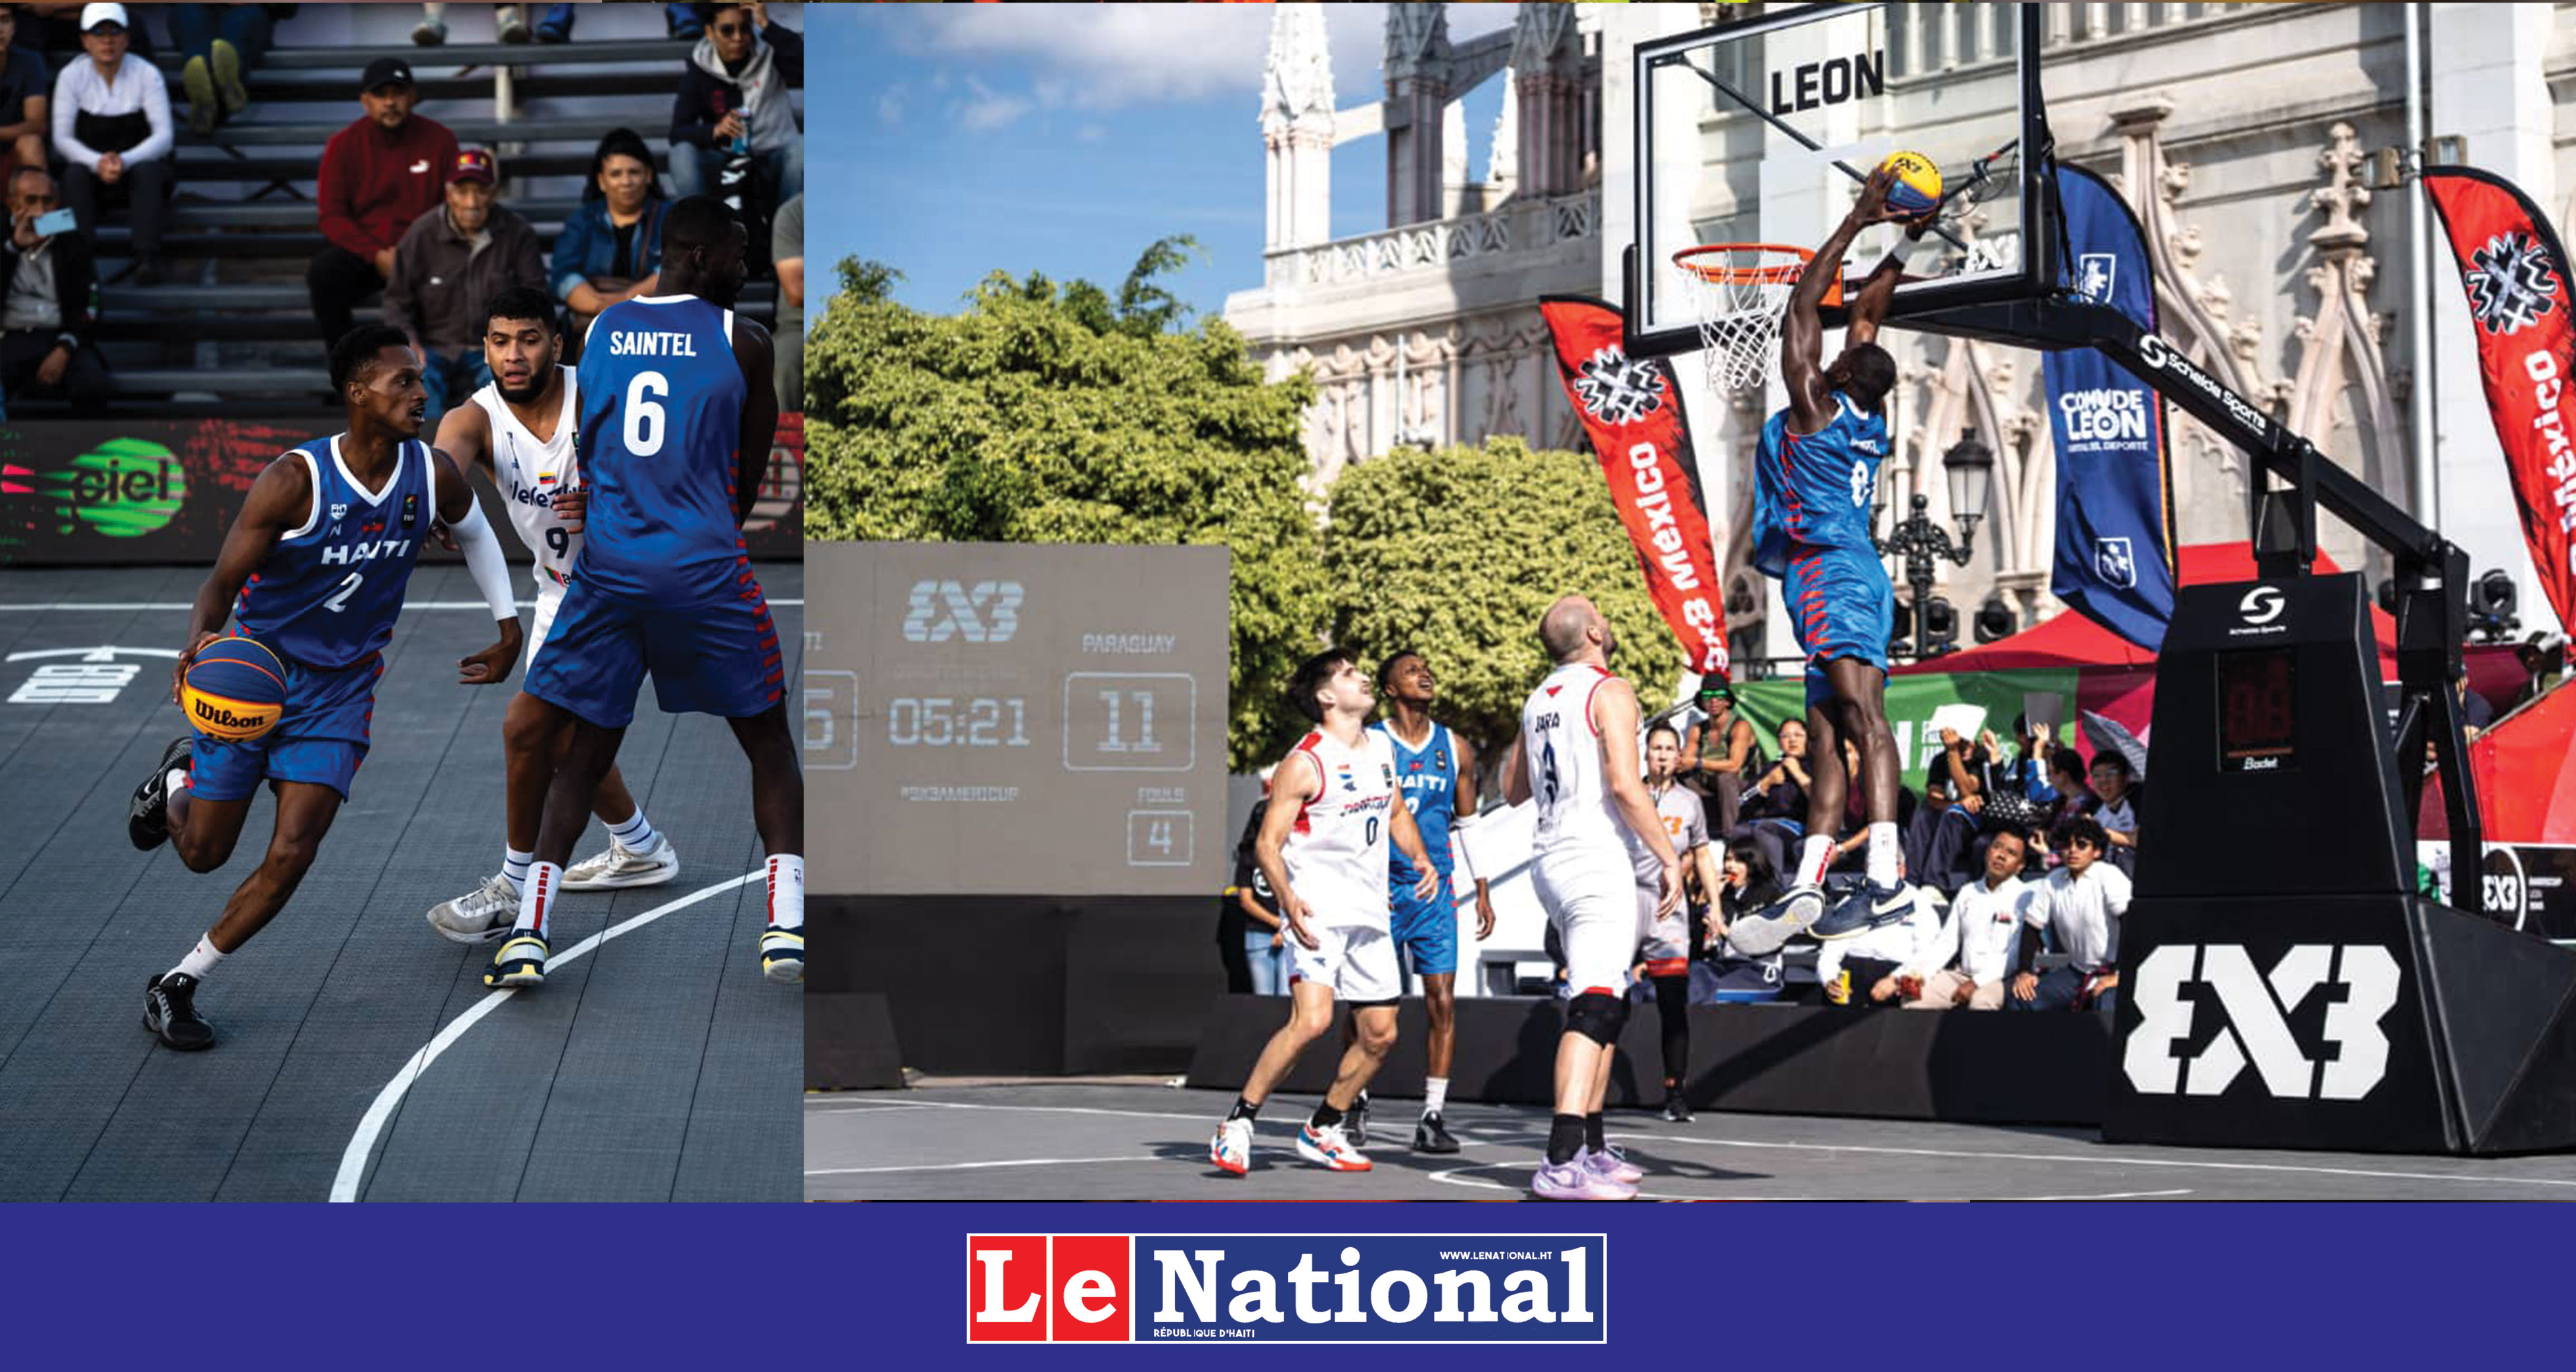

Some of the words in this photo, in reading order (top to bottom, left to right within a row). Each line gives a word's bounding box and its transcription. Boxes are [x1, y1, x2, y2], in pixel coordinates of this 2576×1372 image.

[1772, 49, 1883, 116] LEON
[610, 331, 697, 357] SAINTEL
[624, 371, 668, 457] 6
[321, 539, 411, 565] HAITI
[545, 527, 569, 559] 9
[323, 572, 363, 612] 2
[1083, 633, 1176, 653] PARAGUAY
[196, 698, 264, 728] Wilson
[889, 698, 1030, 746] 05:21
[1096, 691, 1162, 752] 11
[1397, 773, 1447, 792] AITI
[1149, 820, 1172, 855] 4
[1366, 816, 1379, 846] 0
